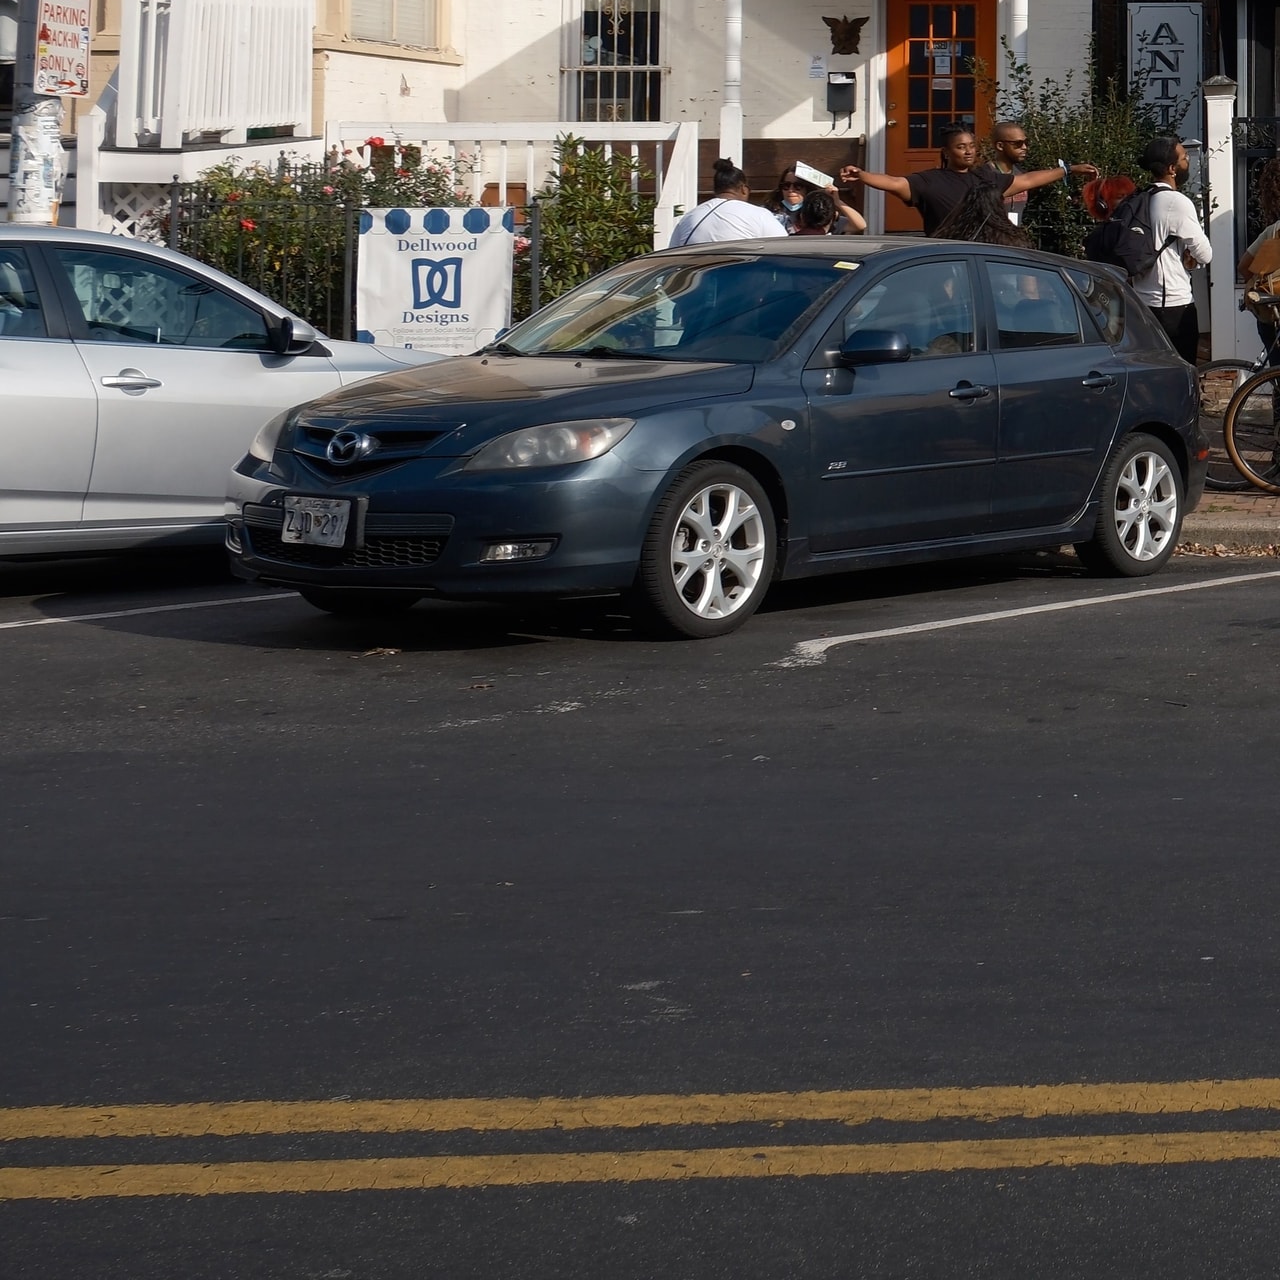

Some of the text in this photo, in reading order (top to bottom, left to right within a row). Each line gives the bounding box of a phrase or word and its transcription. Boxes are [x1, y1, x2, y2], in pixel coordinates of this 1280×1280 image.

[43, 3, 86, 27] PARKING
[46, 28, 80, 49] BACK-IN
[48, 54, 75, 72] ONLY
[397, 238, 477, 252] Dellwood
[402, 310, 469, 326] Designs
